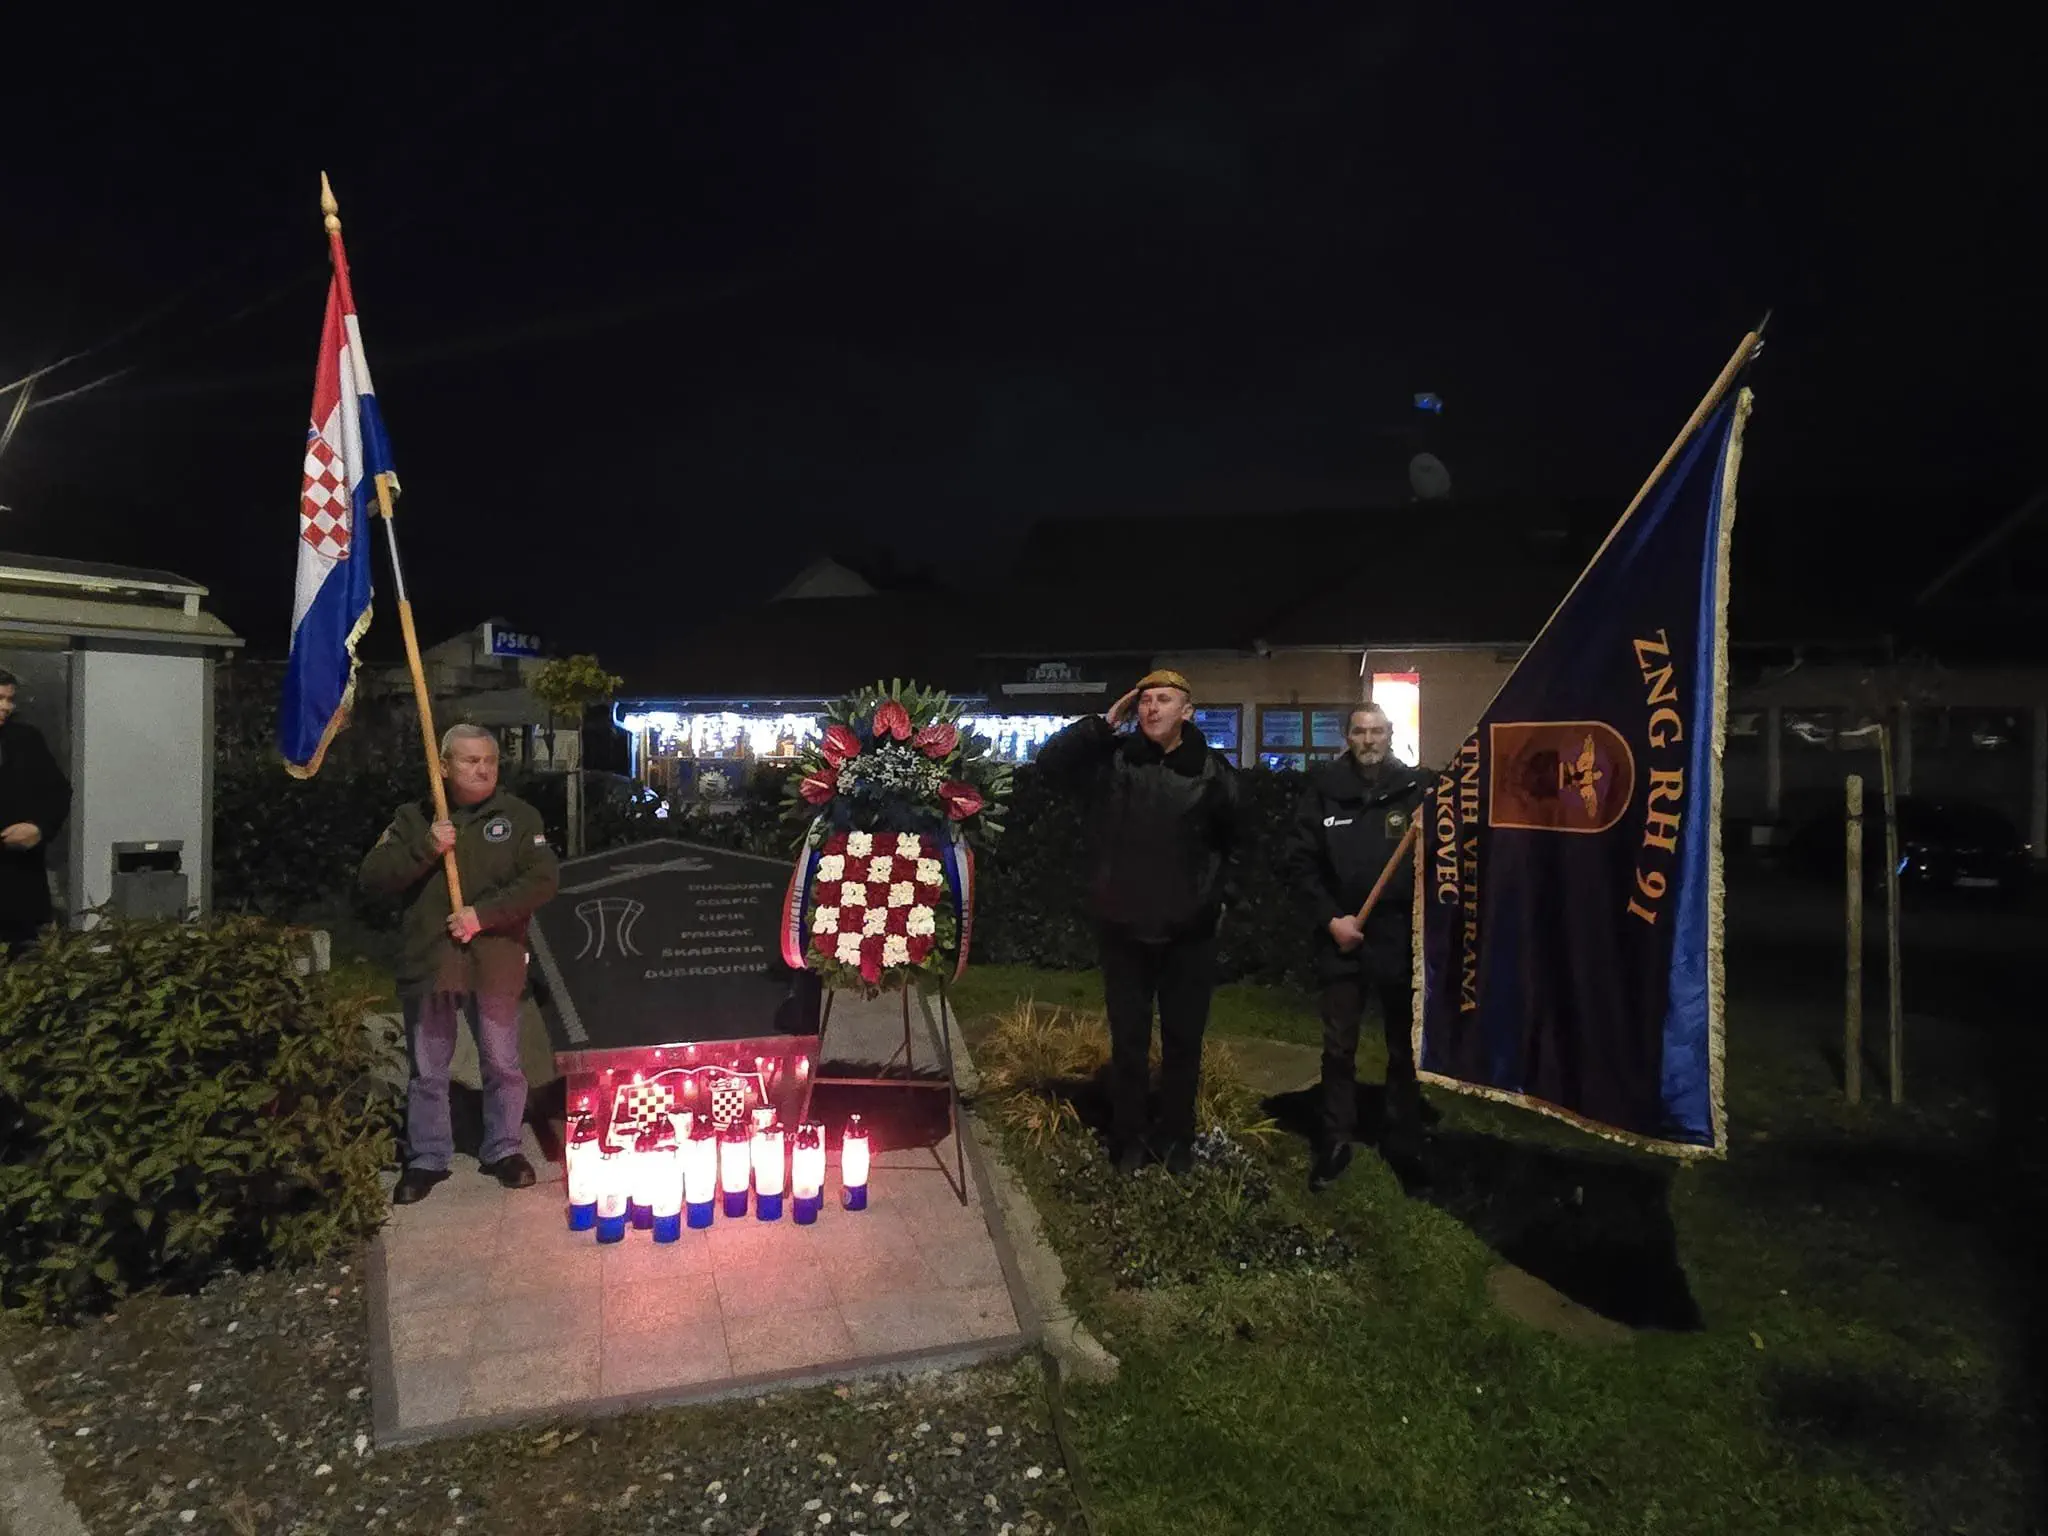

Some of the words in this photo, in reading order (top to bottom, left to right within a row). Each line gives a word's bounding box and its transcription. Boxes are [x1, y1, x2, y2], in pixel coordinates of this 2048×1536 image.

[1632, 628, 1684, 750] ZNG
[1460, 736, 1481, 827] TNIH
[1641, 768, 1685, 855] RH
[1460, 838, 1479, 1013] VETERANA
[1626, 863, 1668, 926] 91
